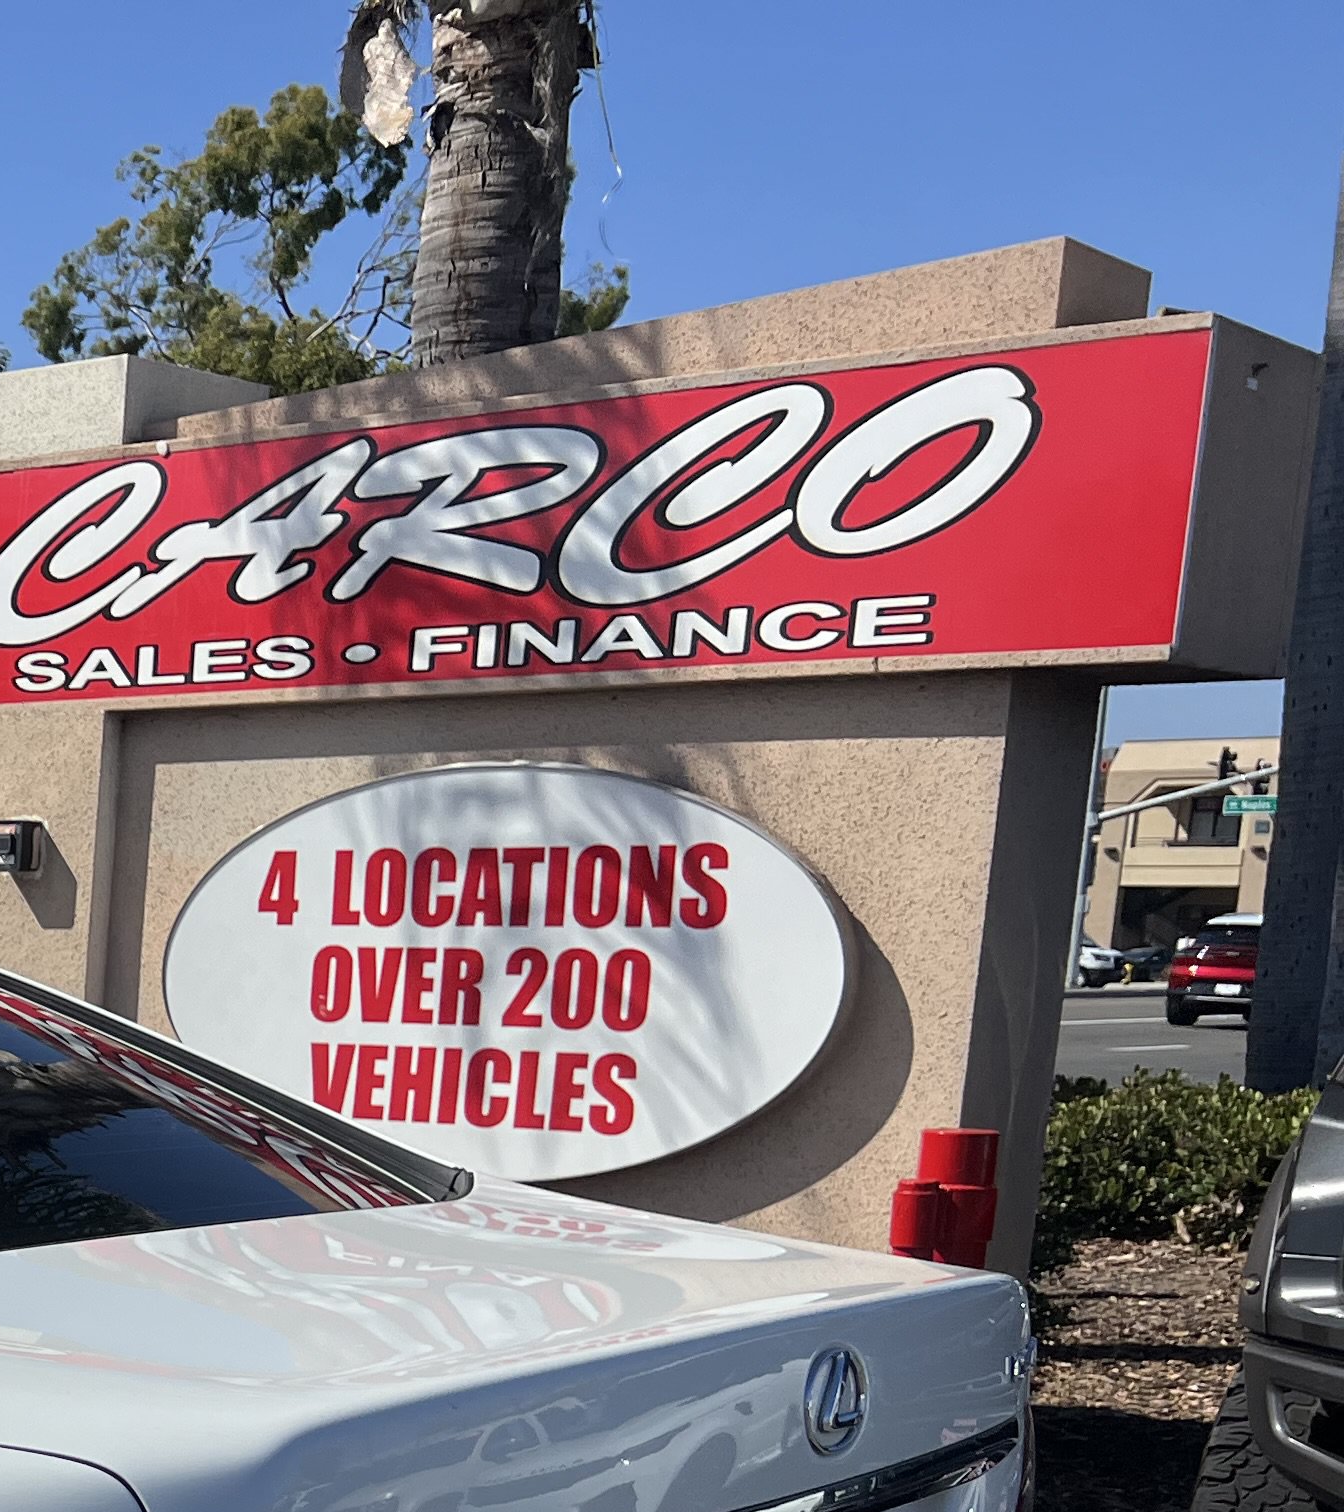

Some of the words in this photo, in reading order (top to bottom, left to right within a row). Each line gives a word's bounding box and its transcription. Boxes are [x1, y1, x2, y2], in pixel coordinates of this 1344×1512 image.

[13, 635, 314, 695] SALES
[408, 593, 937, 672] FINANCE
[257, 850, 299, 925] 4
[330, 842, 730, 930] LOCATIONS
[310, 945, 483, 1026] OVER
[501, 948, 651, 1032] 200
[310, 1043, 637, 1135] VEHICLES
